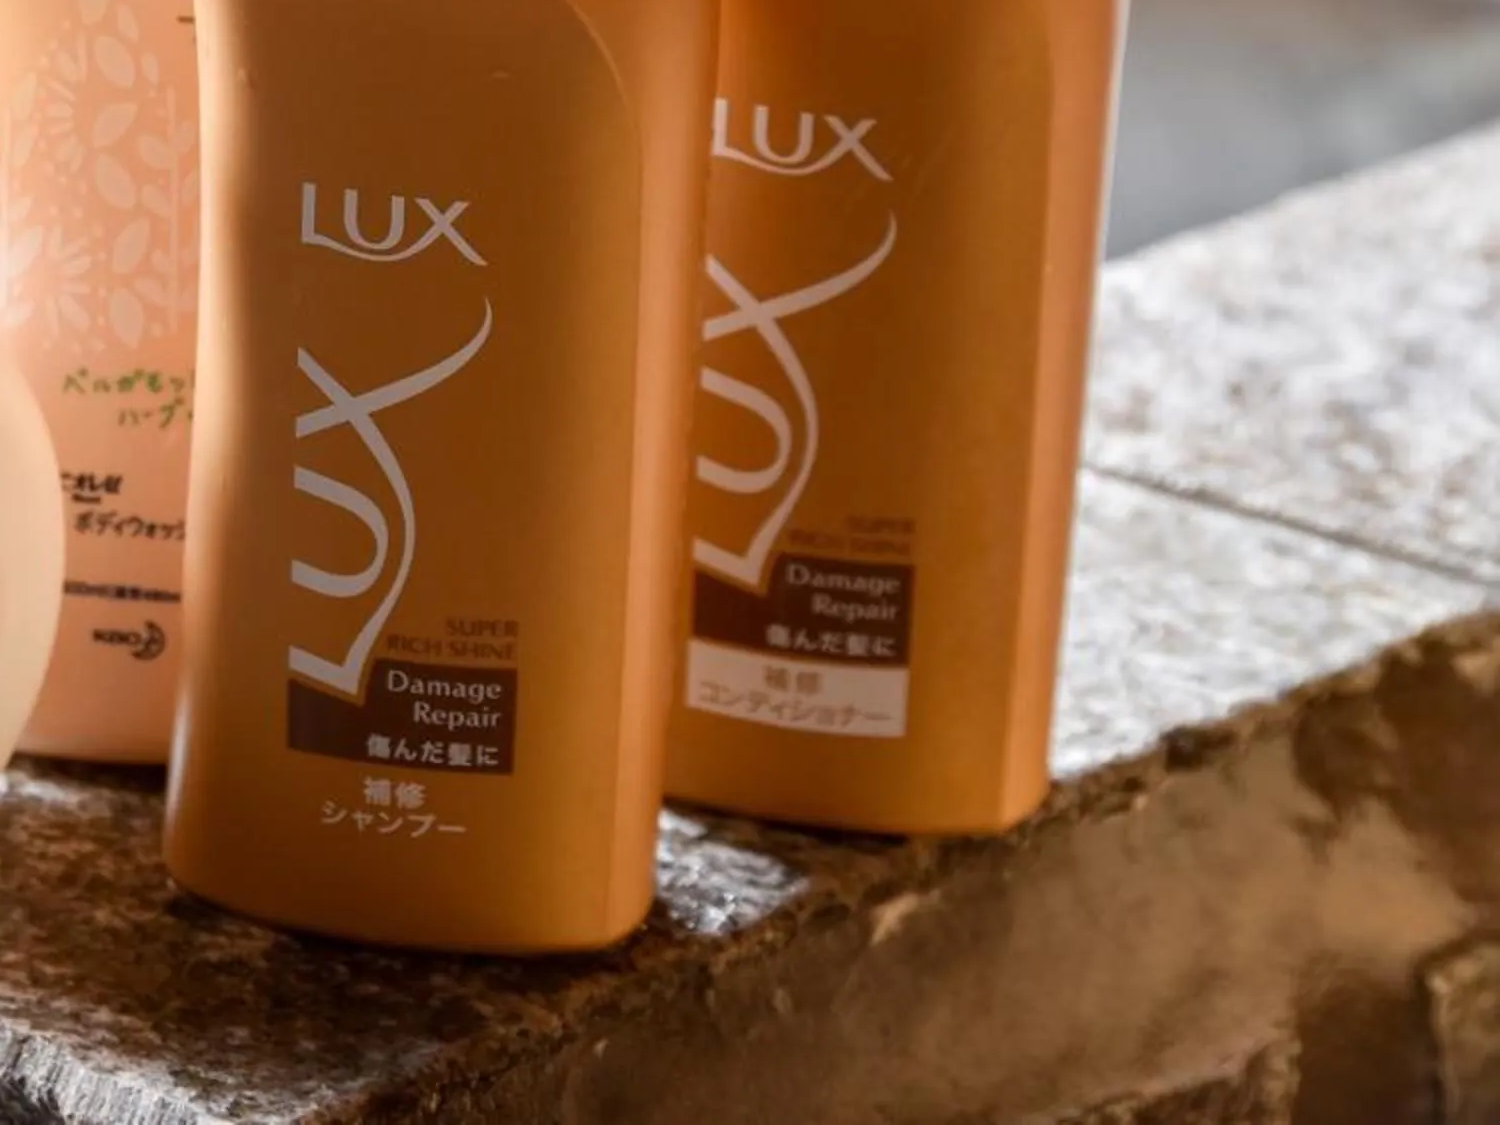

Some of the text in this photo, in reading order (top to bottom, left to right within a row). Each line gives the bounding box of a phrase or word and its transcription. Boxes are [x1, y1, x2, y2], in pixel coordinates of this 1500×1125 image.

[711, 98, 893, 181] LUX
[302, 182, 487, 266] LUX
[63, 366, 195, 394] ベルガモッ
[693, 208, 897, 586] LUX
[289, 296, 493, 696] LUX
[785, 562, 901, 596] Damage
[811, 591, 899, 623] Repair
[386, 668, 503, 704] Damage
[412, 700, 502, 731] Repair
[365, 732, 499, 767] 傷んだ髪に
